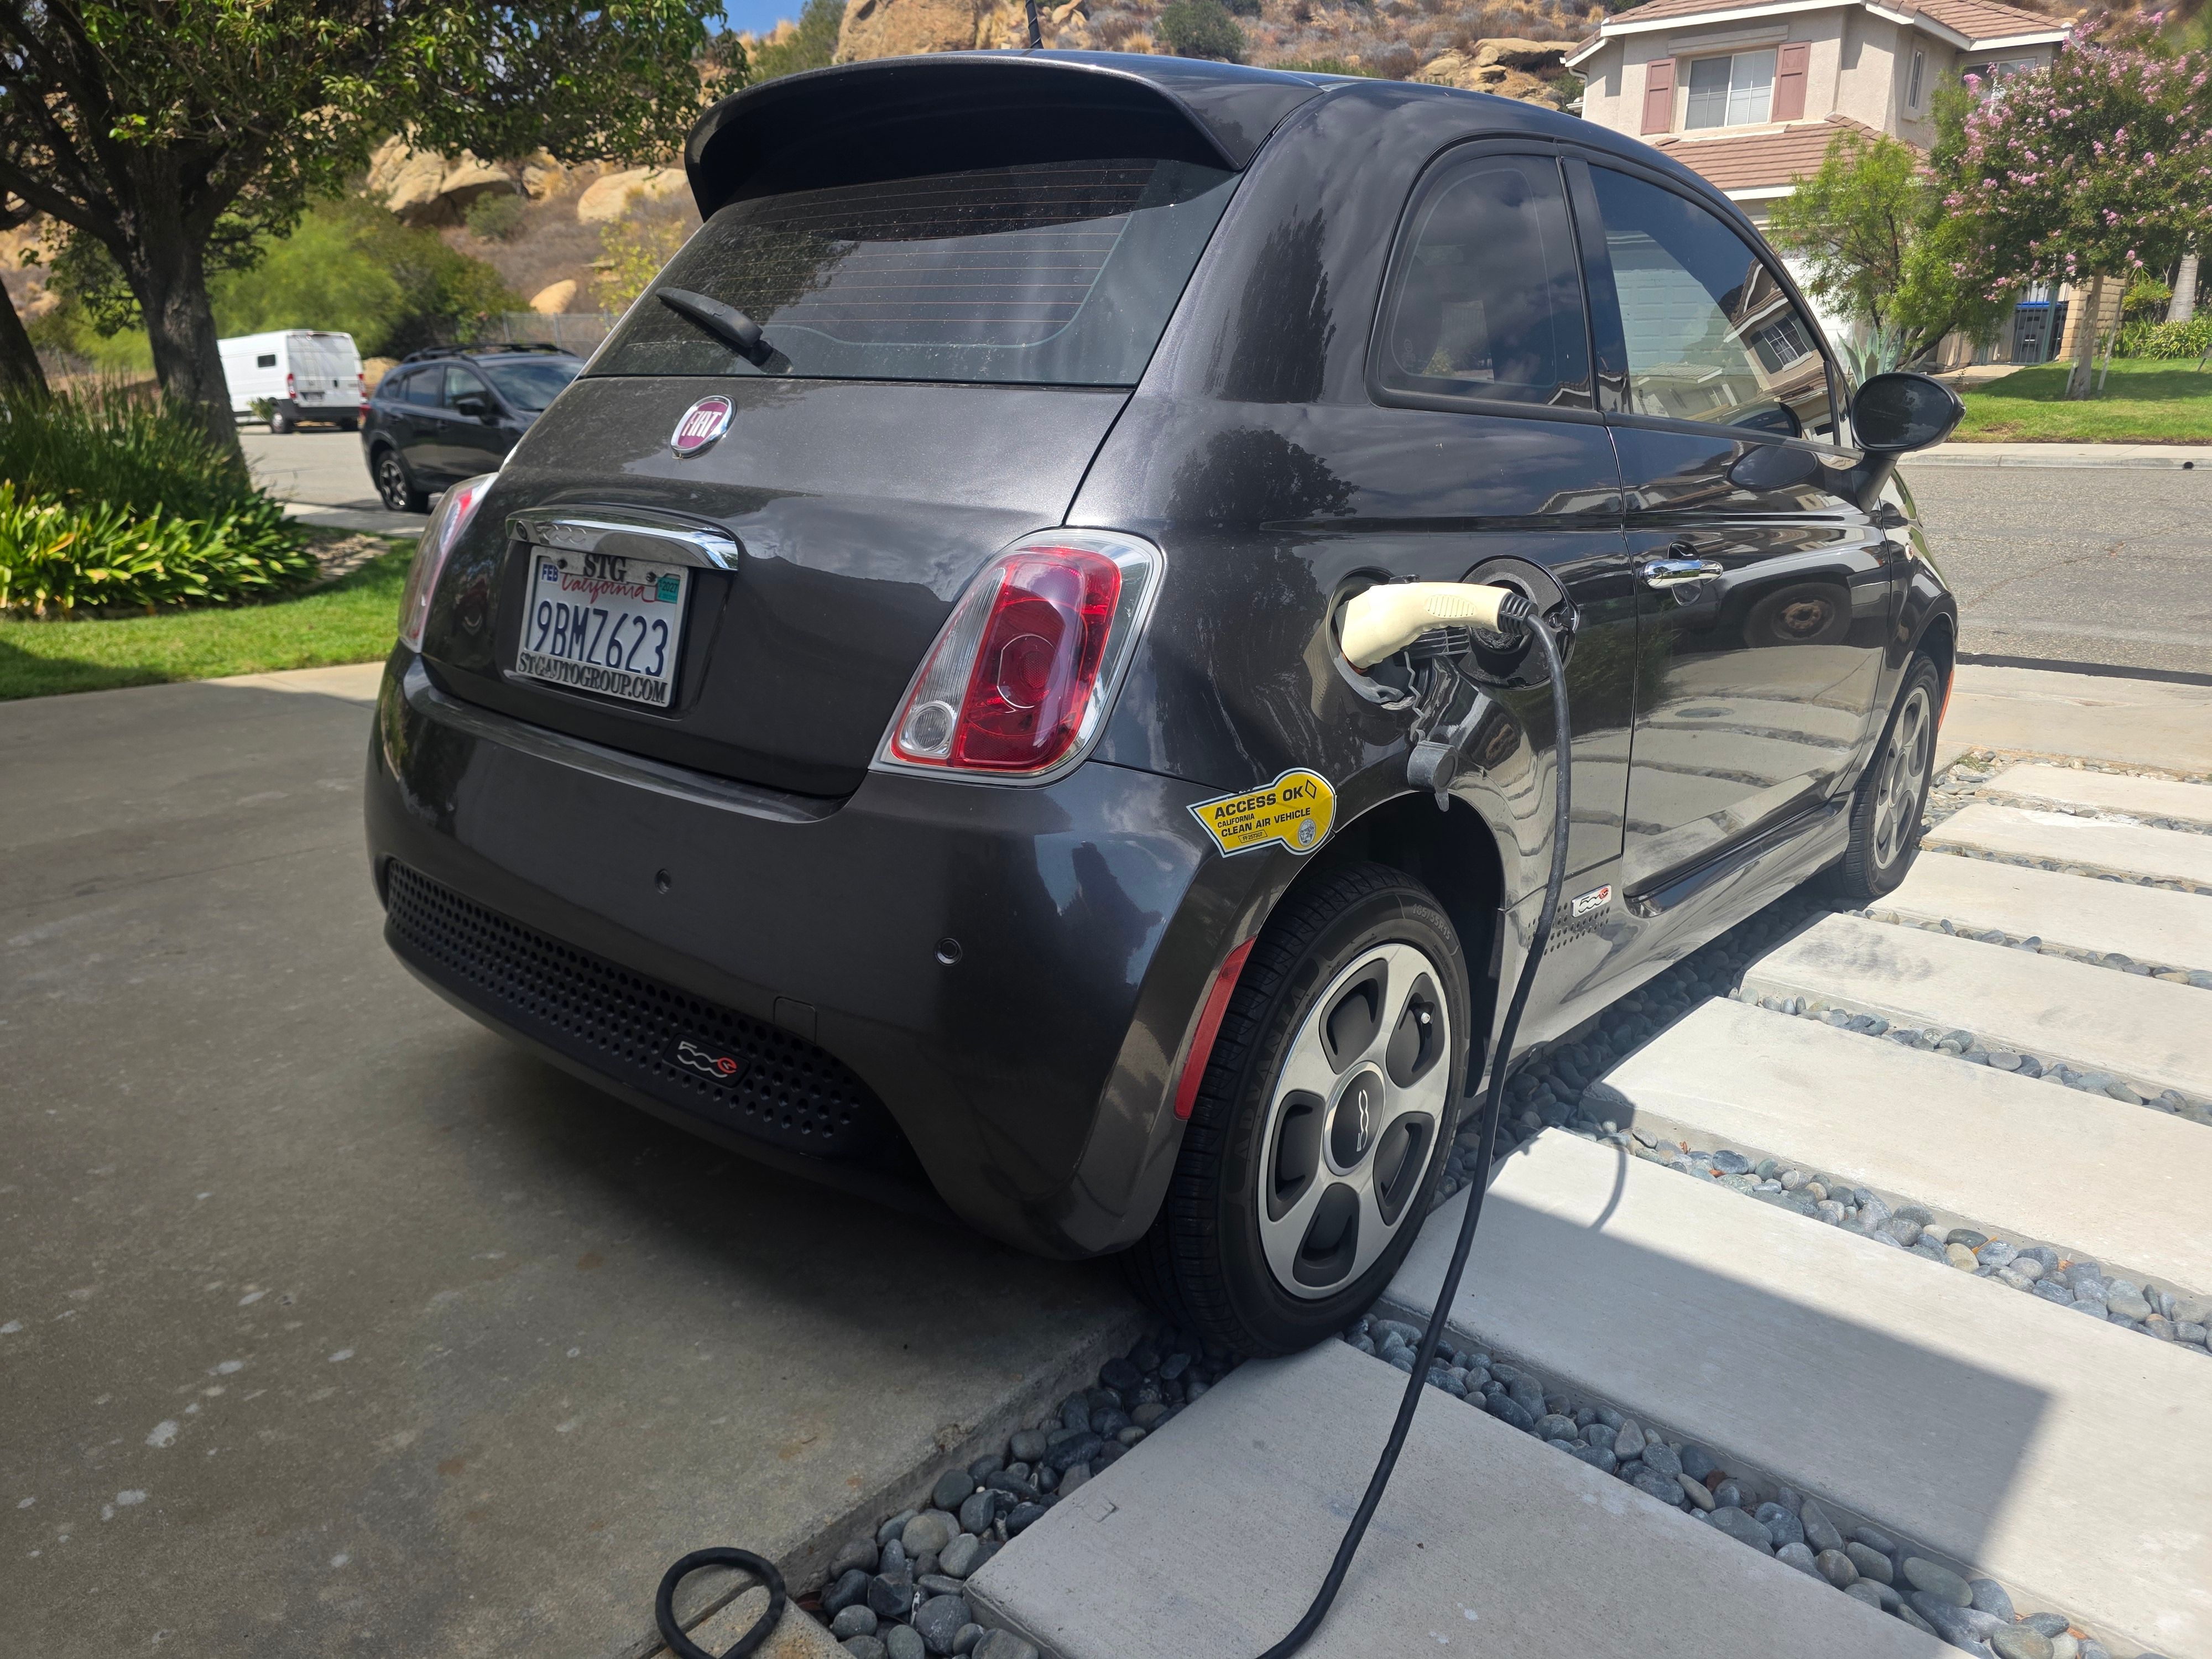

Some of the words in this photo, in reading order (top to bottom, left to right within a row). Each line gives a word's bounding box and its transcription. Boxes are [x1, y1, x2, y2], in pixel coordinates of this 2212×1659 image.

[681, 410, 723, 439] FIAT
[541, 563, 559, 582] FEB
[583, 554, 627, 583] STG
[561, 572, 656, 604] California
[533, 600, 669, 677] 9BMZ623
[518, 652, 669, 705] STGAUTOGROUP.COM
[1214, 793, 1276, 820] ACCESS
[1282, 785, 1303, 801] OK
[1217, 813, 1255, 828] CALIFORNIA
[1221, 822, 1253, 838] CLEAN
[1255, 817, 1271, 829] AIR
[1274, 807, 1311, 824] VEHICLE
